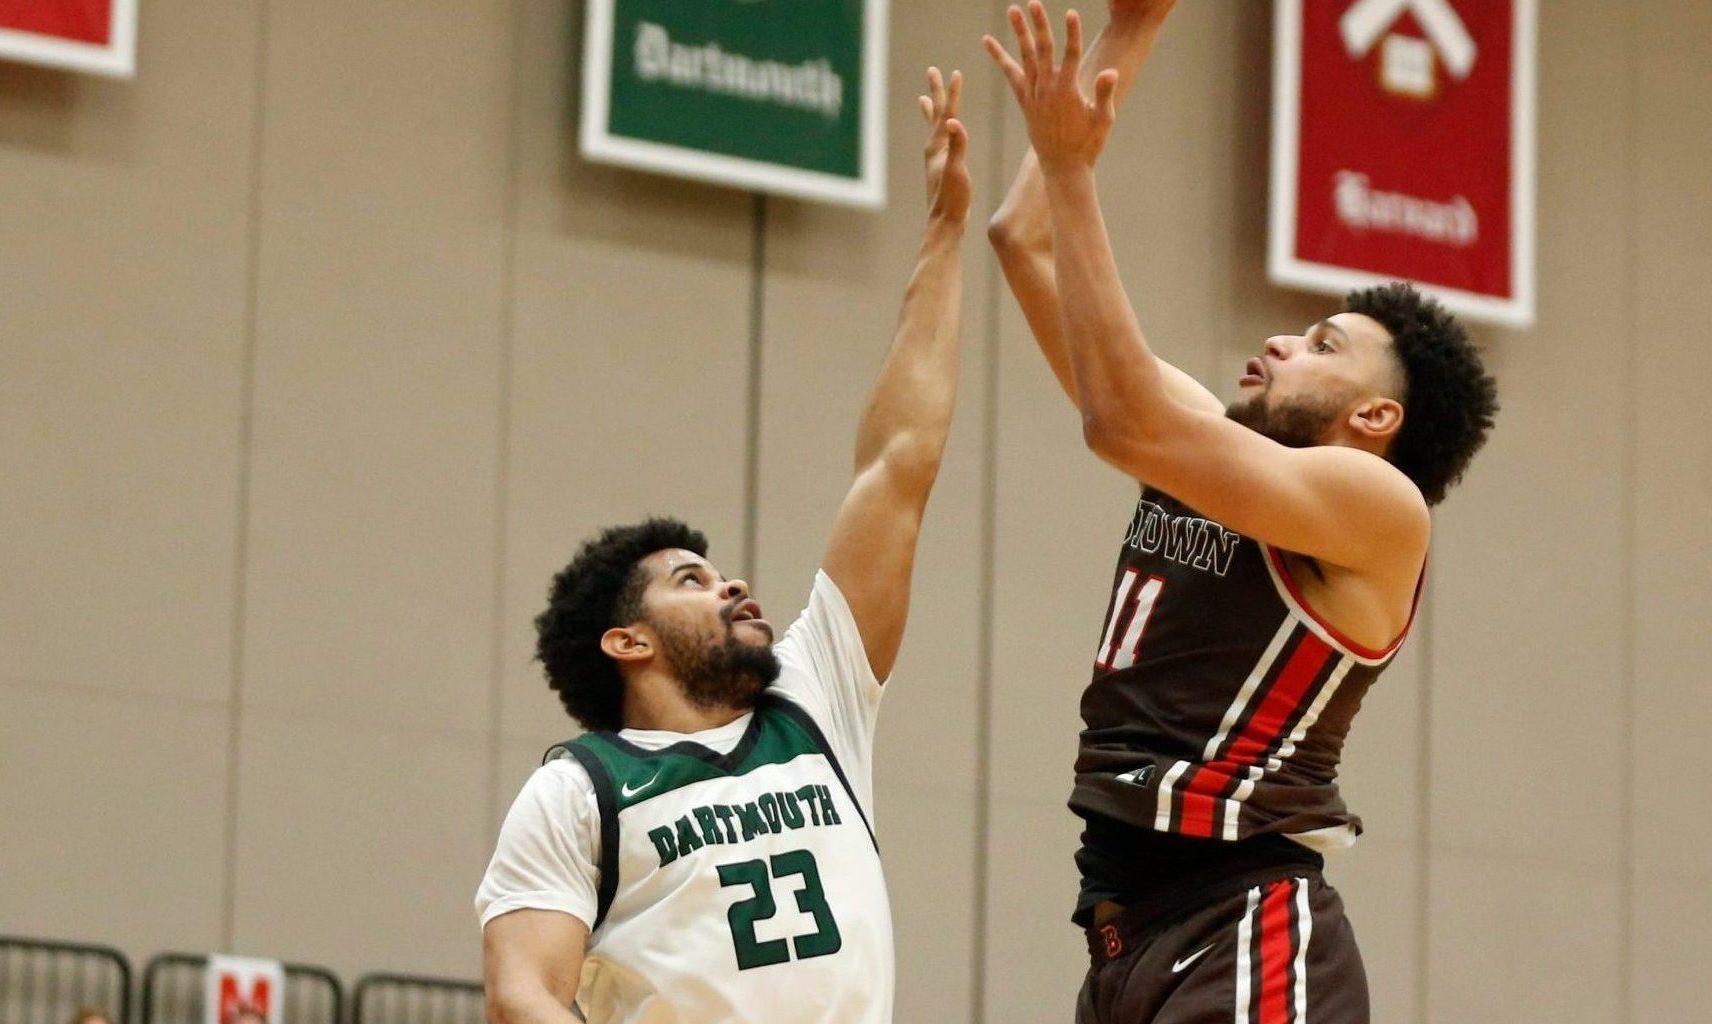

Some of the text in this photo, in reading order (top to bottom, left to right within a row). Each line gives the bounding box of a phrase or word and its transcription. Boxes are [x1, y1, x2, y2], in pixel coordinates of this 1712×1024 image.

[1122, 499, 1240, 577] OWN
[1095, 565, 1168, 671] 11
[648, 784, 842, 868] DARTMOUTH
[716, 849, 842, 971] 23
[1101, 925, 1122, 957] B
